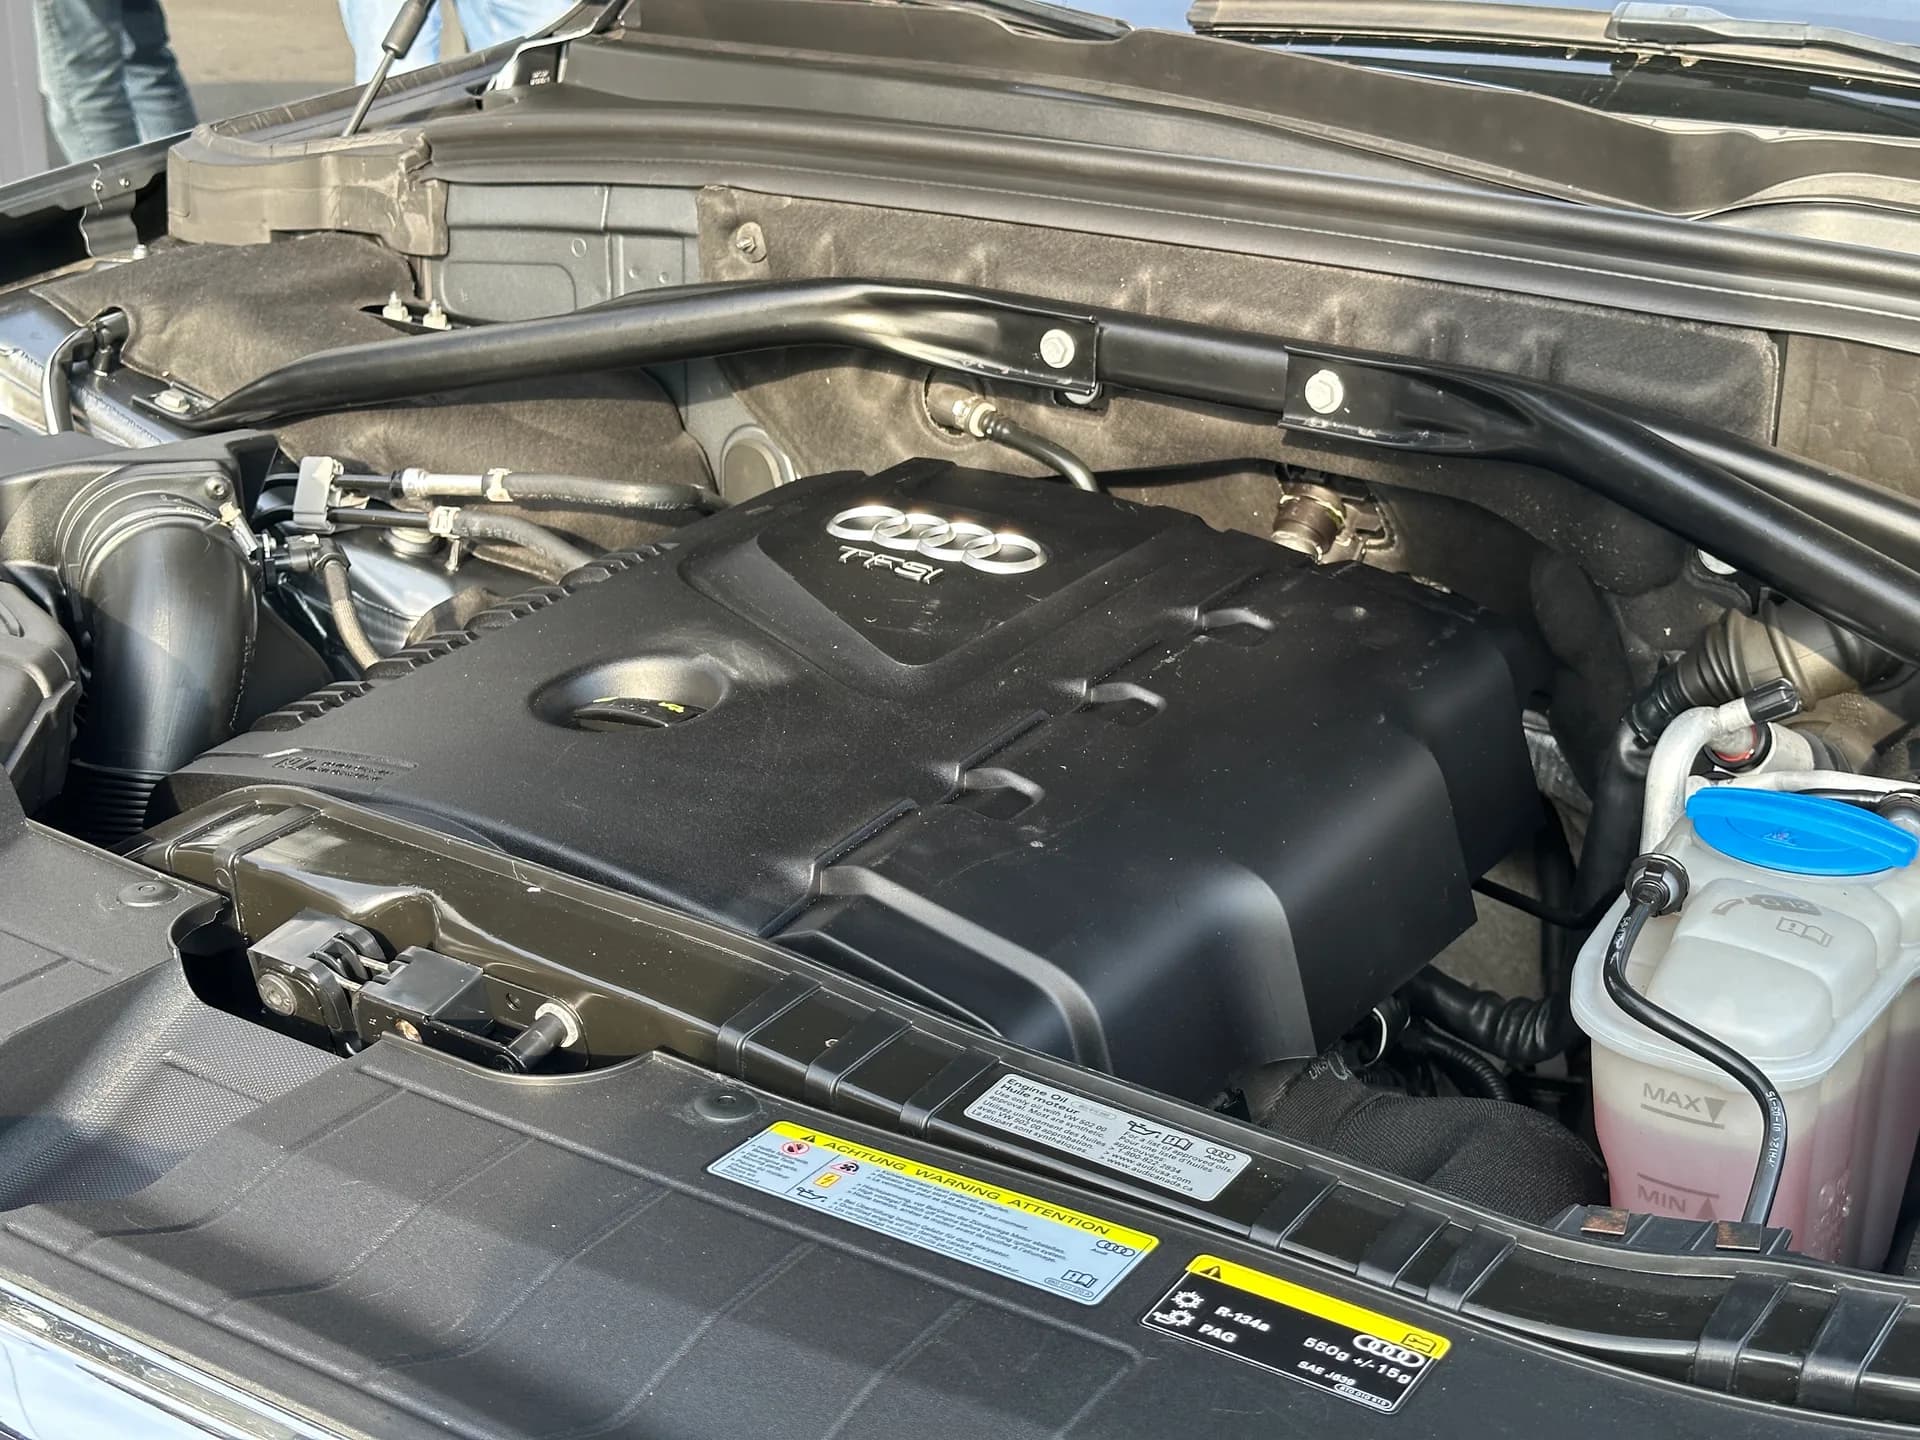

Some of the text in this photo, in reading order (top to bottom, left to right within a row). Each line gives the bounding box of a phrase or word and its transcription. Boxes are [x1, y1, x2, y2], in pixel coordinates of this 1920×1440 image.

[838, 545, 944, 584] TFSI
[999, 1083, 1032, 1098] Huile
[1032, 1095, 1081, 1115] moteur
[1005, 1078, 1069, 1103] Engine Oil
[1643, 1082, 1700, 1113] MAX
[970, 1108, 984, 1116] La
[981, 1113, 1014, 1127] plupart
[1013, 1124, 1033, 1134] sont
[981, 1099, 1014, 1113] Utilisez
[1011, 1110, 1064, 1131] uniquement
[1062, 1128, 1080, 1137] des
[1079, 1134, 1107, 1146] huiles
[987, 1094, 1107, 1138] approval. Most are synthetic.
[992, 1089, 1011, 1098] Use
[1009, 1096, 1029, 1105] only
[1041, 1106, 1062, 1116] with
[1061, 1113, 1079, 1122] VW
[1077, 1118, 1095, 1128] 502
[1094, 1124, 1108, 1132] 00
[976, 1105, 997, 1114] avec
[996, 1111, 1014, 1120] VW
[1012, 1117, 1030, 1126] 502
[1039, 1127, 1096, 1149] approbation.
[1115, 1148, 1182, 1174] 1-800-822-2834
[1117, 1135, 1214, 1172] Pour une liste d'huiles
[1122, 1131, 1141, 1140] For
[1146, 1139, 1161, 1147] list
[1171, 1149, 1215, 1167] approved
[1203, 1153, 1227, 1164] Audi
[1104, 1157, 1195, 1191] www.audicanada.ca
[1108, 1152, 1193, 1184] www.audiusa.com
[824, 1141, 906, 1171] ACHTUNG
[915, 1168, 1000, 1200] WARNING
[1008, 1199, 1110, 1235] ATTENTION
[1637, 1185, 1686, 1213] MIN
[1198, 1324, 1237, 1343] PAG
[1214, 1305, 1271, 1332] R-134a
[1303, 1337, 1350, 1361] 550g
[1298, 1360, 1325, 1377] SAE
